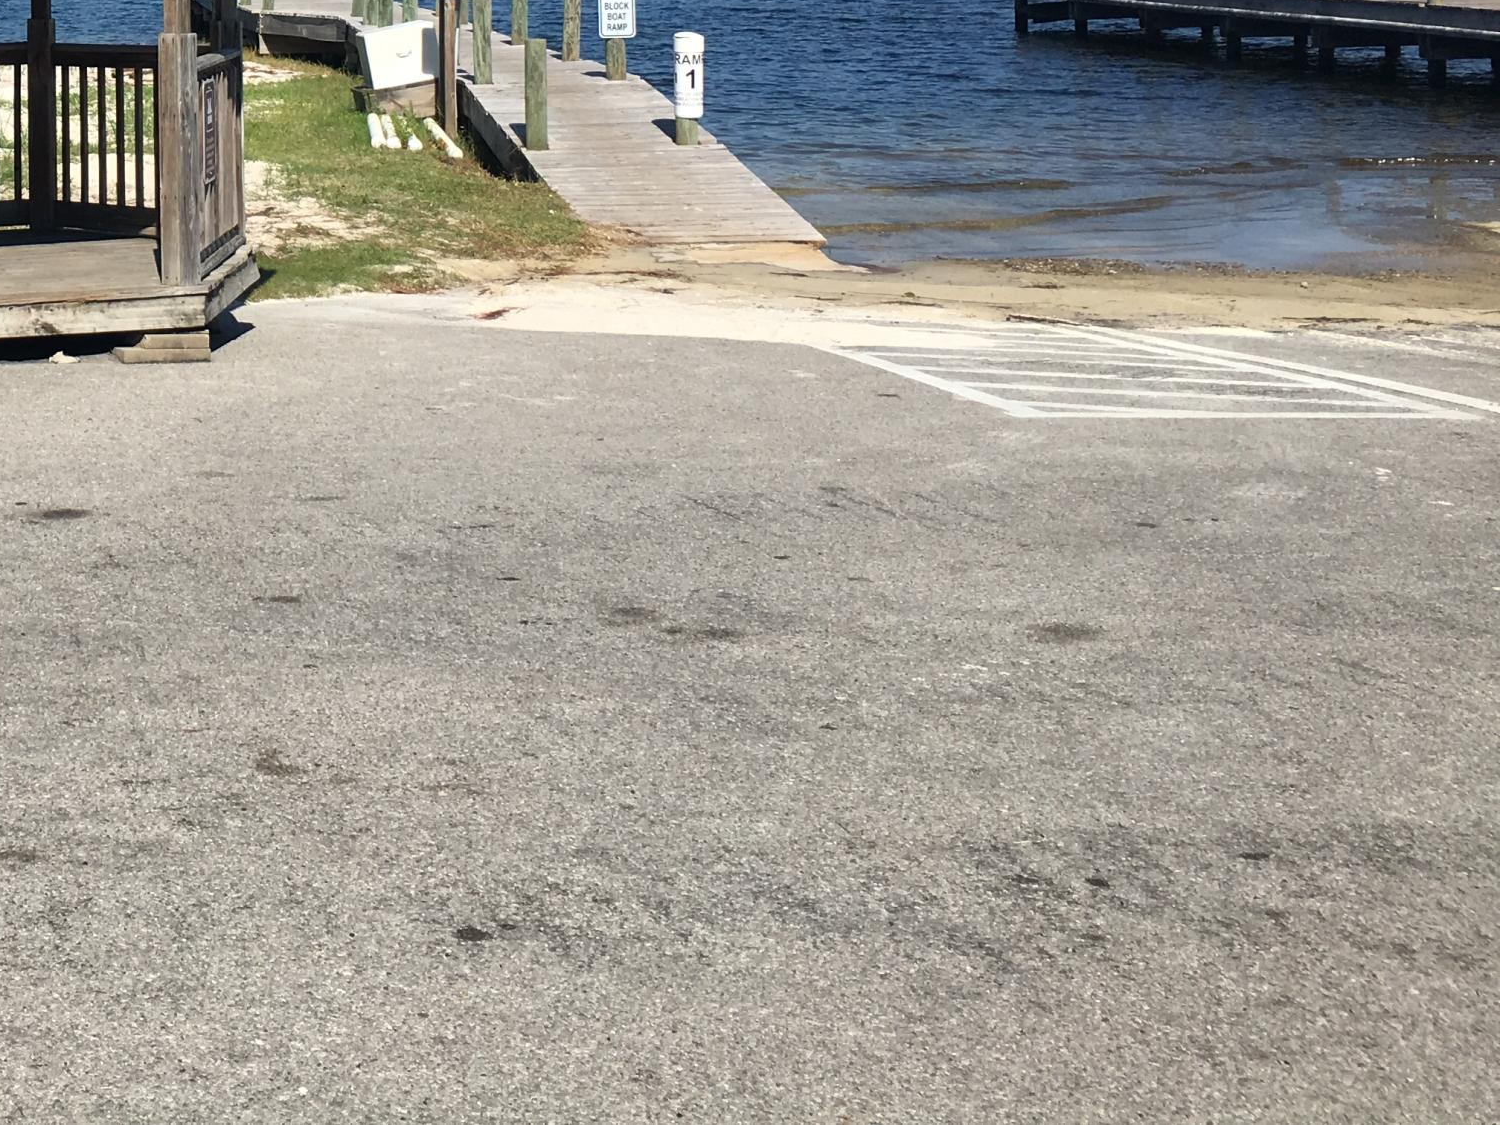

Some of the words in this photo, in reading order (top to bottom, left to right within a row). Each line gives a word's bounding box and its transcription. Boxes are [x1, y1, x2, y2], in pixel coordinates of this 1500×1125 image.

[604, 2, 629, 10] BLOCK
[606, 23, 628, 31] RAMP
[686, 69, 695, 89] 1
